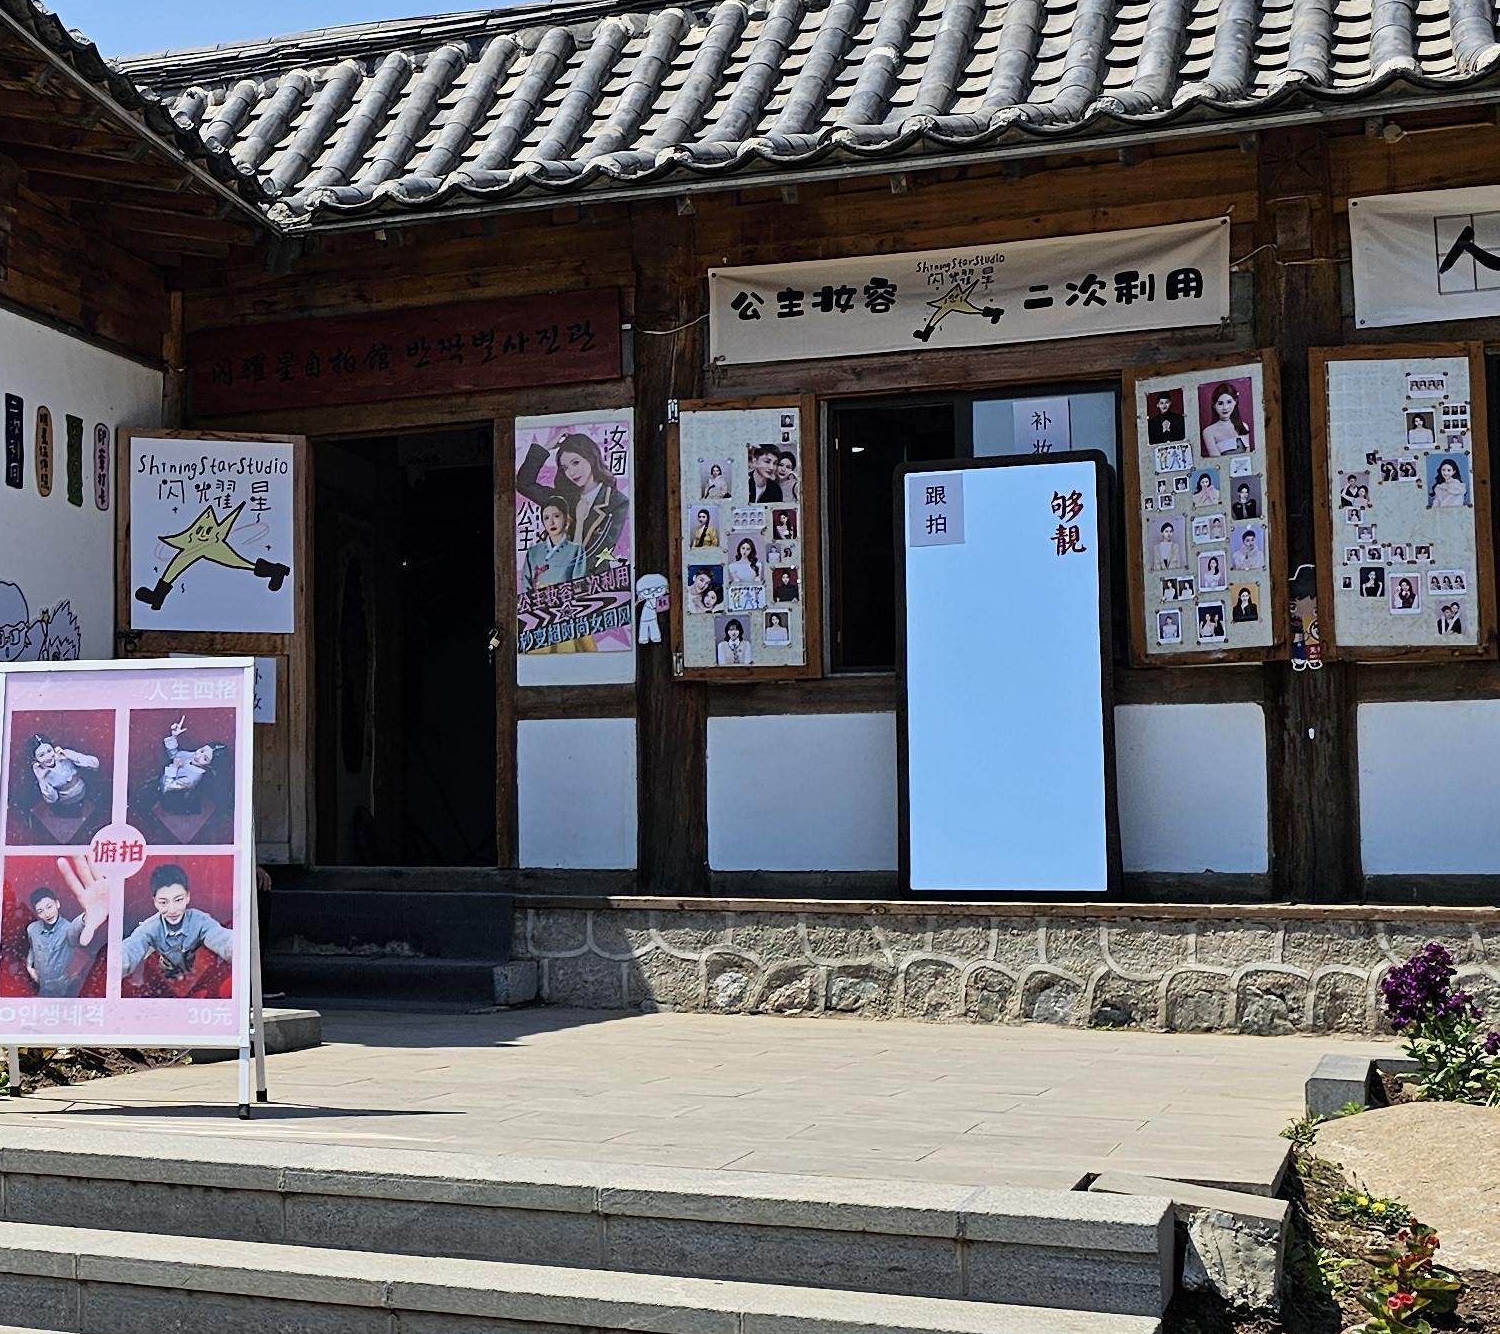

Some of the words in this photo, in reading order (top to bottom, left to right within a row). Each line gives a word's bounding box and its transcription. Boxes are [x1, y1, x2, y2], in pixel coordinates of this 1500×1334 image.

[1438, 225, 1500, 275] 人
[730, 276, 898, 321] 公主妆容
[1023, 267, 1204, 310] 二次利用
[608, 425, 628, 476] 女团
[517, 501, 535, 552] 公主
[924, 485, 948, 535] 跟拍
[518, 604, 632, 653] 秒变超时尚女团风
[148, 679, 237, 701] 人生四格
[92, 839, 143, 863] 俯拍
[187, 1007, 233, 1026] 30元
